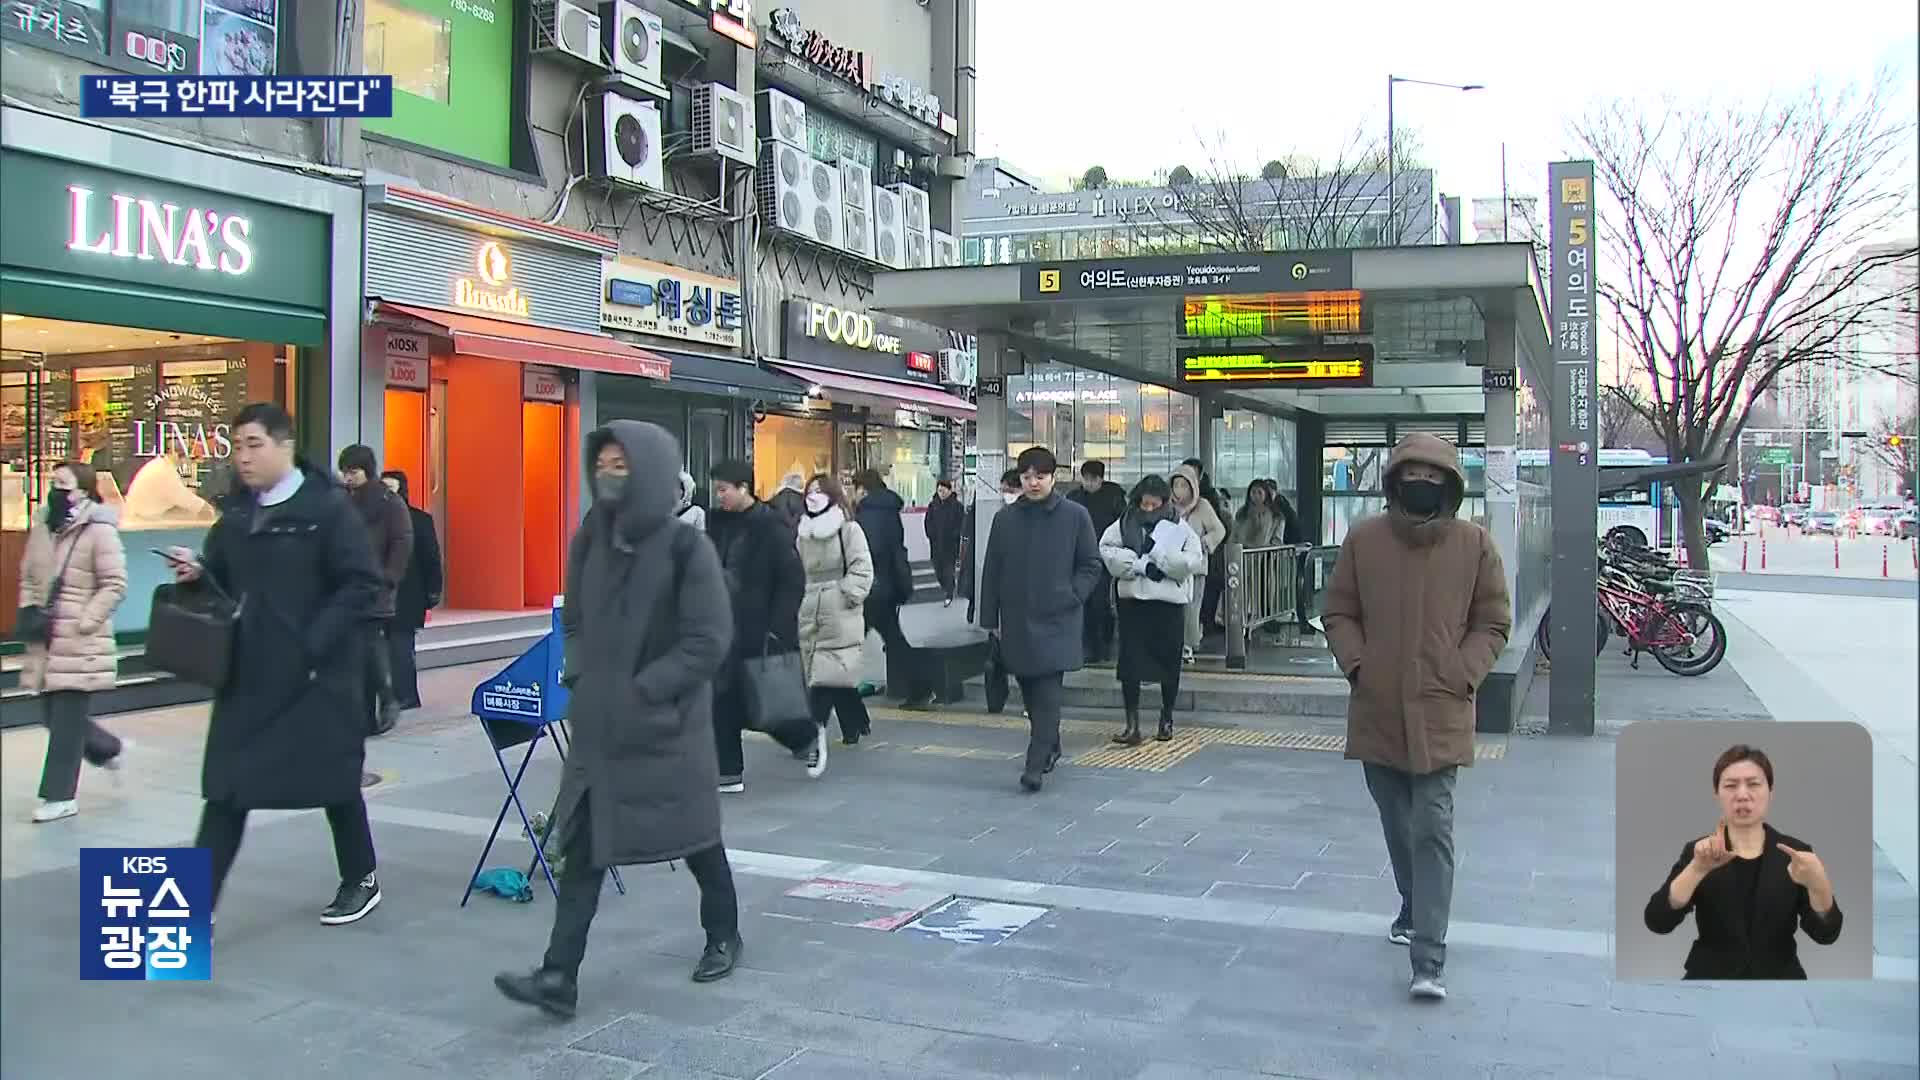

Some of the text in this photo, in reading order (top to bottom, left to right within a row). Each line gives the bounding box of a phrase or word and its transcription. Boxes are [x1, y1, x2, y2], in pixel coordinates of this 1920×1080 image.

[66, 184, 252, 276] LINA'S
[1569, 218, 1588, 245] 5
[1045, 273, 1055, 288] 5
[1567, 247, 1589, 317] 여의도
[388, 337, 418, 353] KIOSK
[806, 302, 901, 355] FOOD CAFE
[147, 382, 220, 415] SANDWICHES
